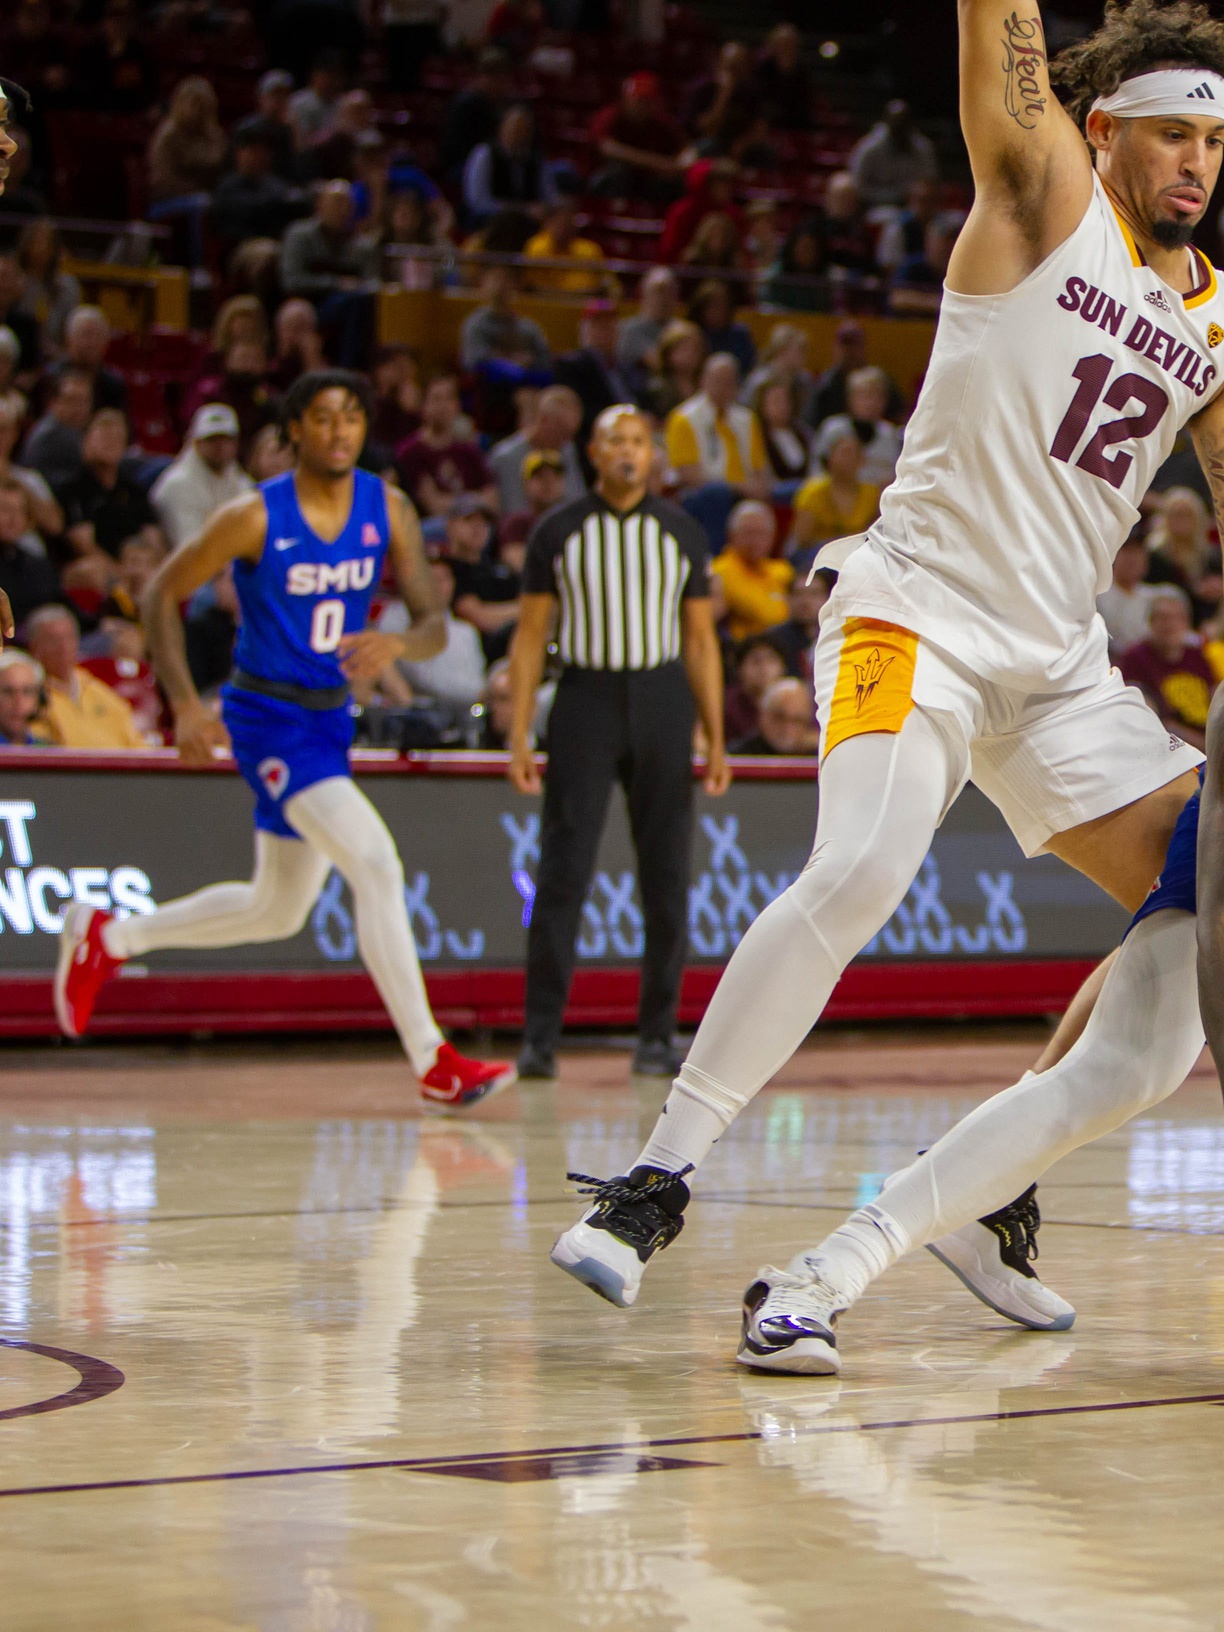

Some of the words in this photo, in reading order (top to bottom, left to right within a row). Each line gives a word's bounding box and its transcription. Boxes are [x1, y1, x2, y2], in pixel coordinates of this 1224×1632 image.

[1143, 294, 1172, 314] adidas
[1056, 276, 1128, 337] SUN
[1123, 314, 1217, 397] DEVILS
[1049, 353, 1170, 489] 12
[285, 556, 375, 596] SMU
[310, 599, 346, 654] 0
[0, 799, 36, 867] T
